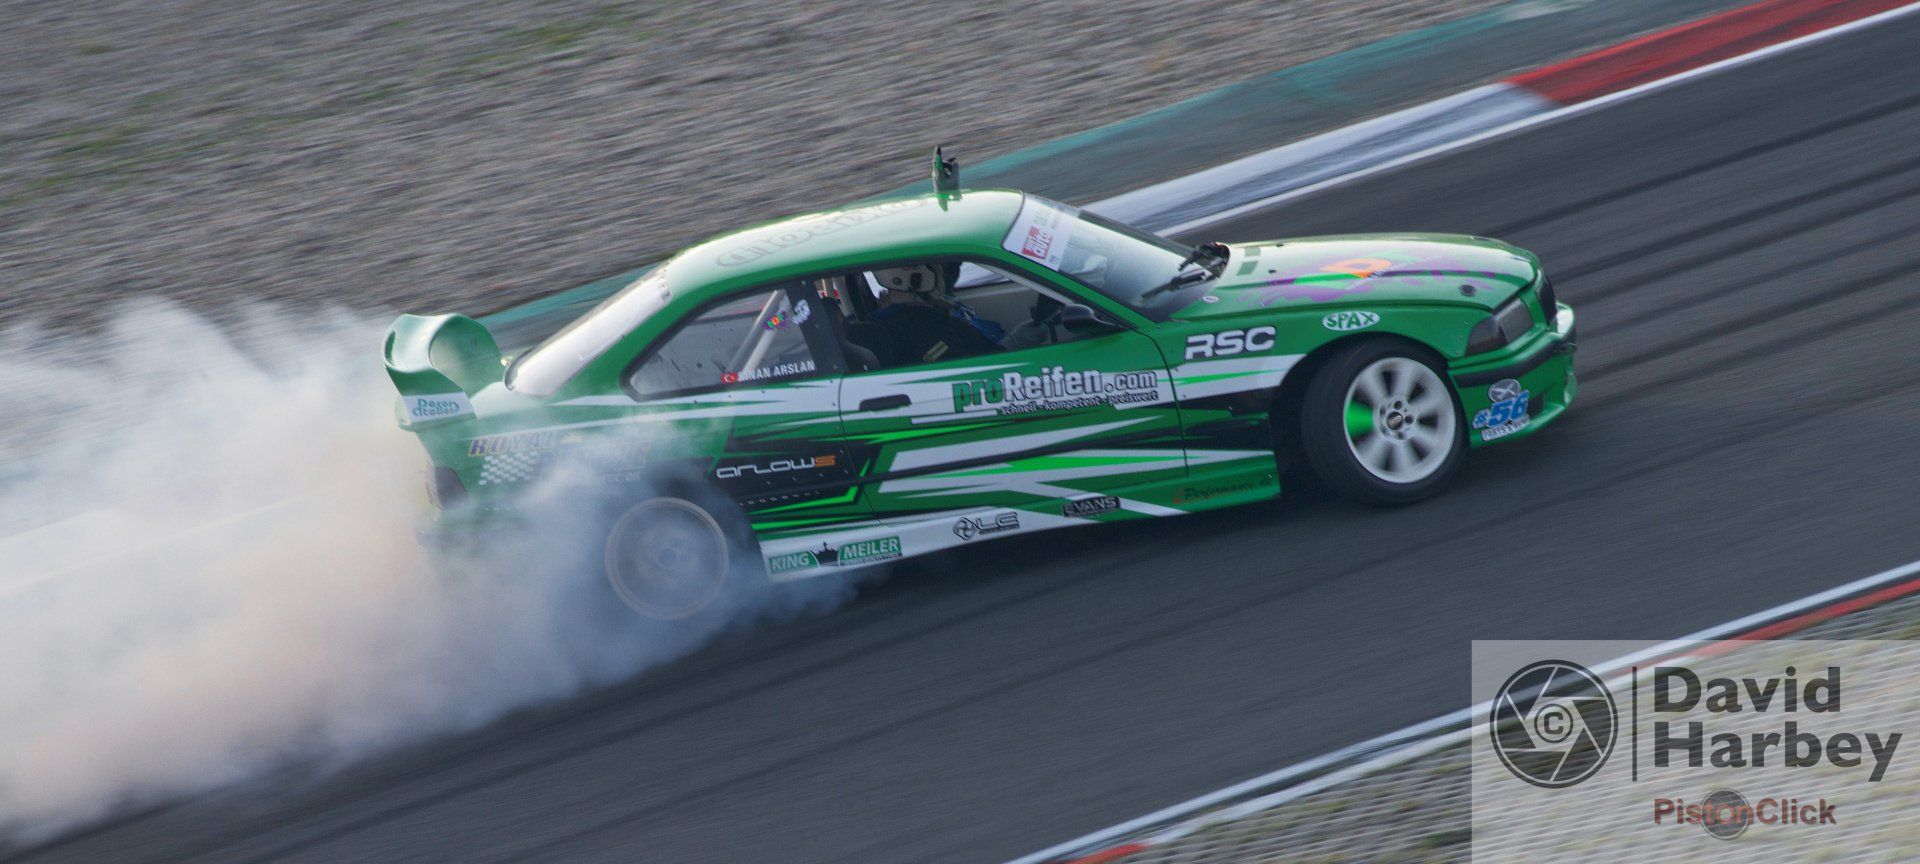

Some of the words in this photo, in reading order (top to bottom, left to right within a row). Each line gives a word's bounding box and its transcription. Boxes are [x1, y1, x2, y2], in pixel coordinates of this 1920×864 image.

[1326, 312, 1375, 329] SPAX
[1184, 326, 1276, 360] RSC
[773, 360, 815, 376] ARSLAN
[1064, 497, 1117, 513] EVANS
[771, 553, 809, 571] KING
[844, 538, 899, 559] MEILER
